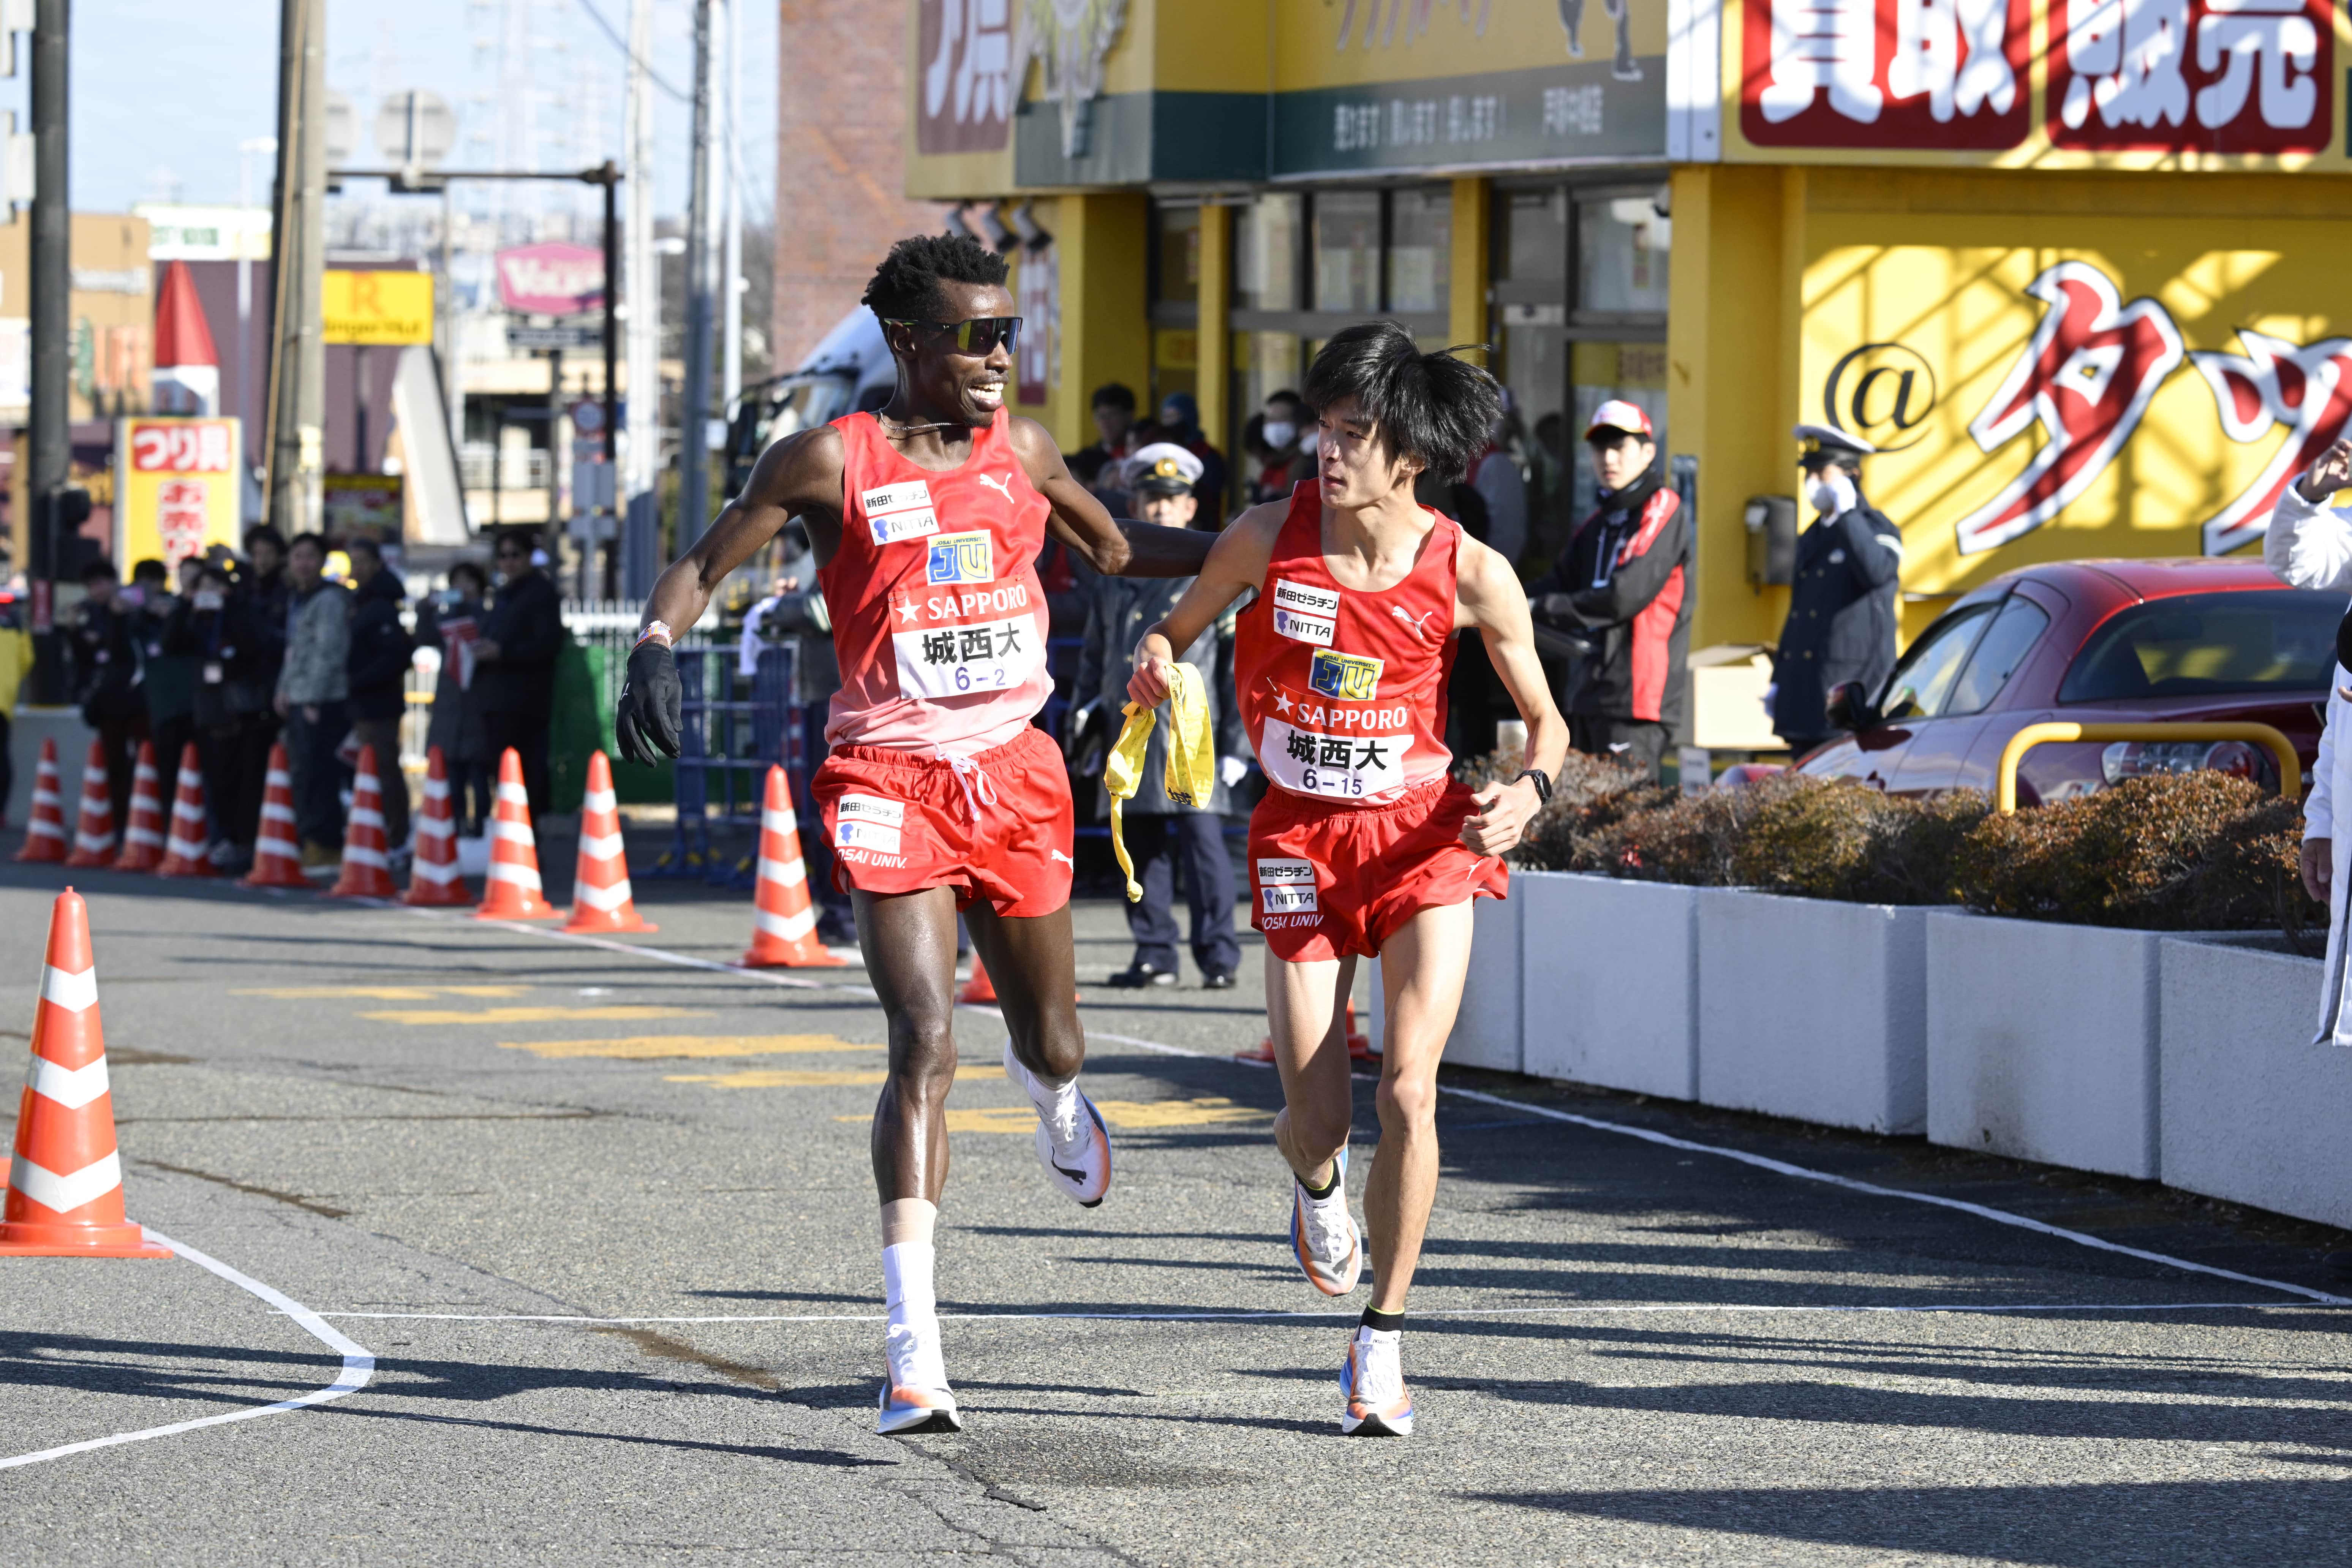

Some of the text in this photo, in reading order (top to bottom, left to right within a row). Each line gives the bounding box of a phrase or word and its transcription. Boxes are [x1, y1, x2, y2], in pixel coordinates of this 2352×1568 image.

[133, 425, 231, 471] つり具
[891, 516, 934, 533] NITTA
[927, 584, 1027, 620] SAPPORO
[1276, 586, 1337, 610] 新田ゼラチン
[1289, 619, 1331, 638] NITTA
[922, 622, 1022, 666] 城西大
[1341, 658, 1376, 669] UNIVERSITY
[1298, 703, 1407, 730] SAPPORO
[1287, 729, 1388, 771] 城西大
[837, 848, 907, 869] OSAI UNIV.
[1259, 866, 1312, 877] 新田ゼラチン
[1275, 893, 1314, 905] NITTA
